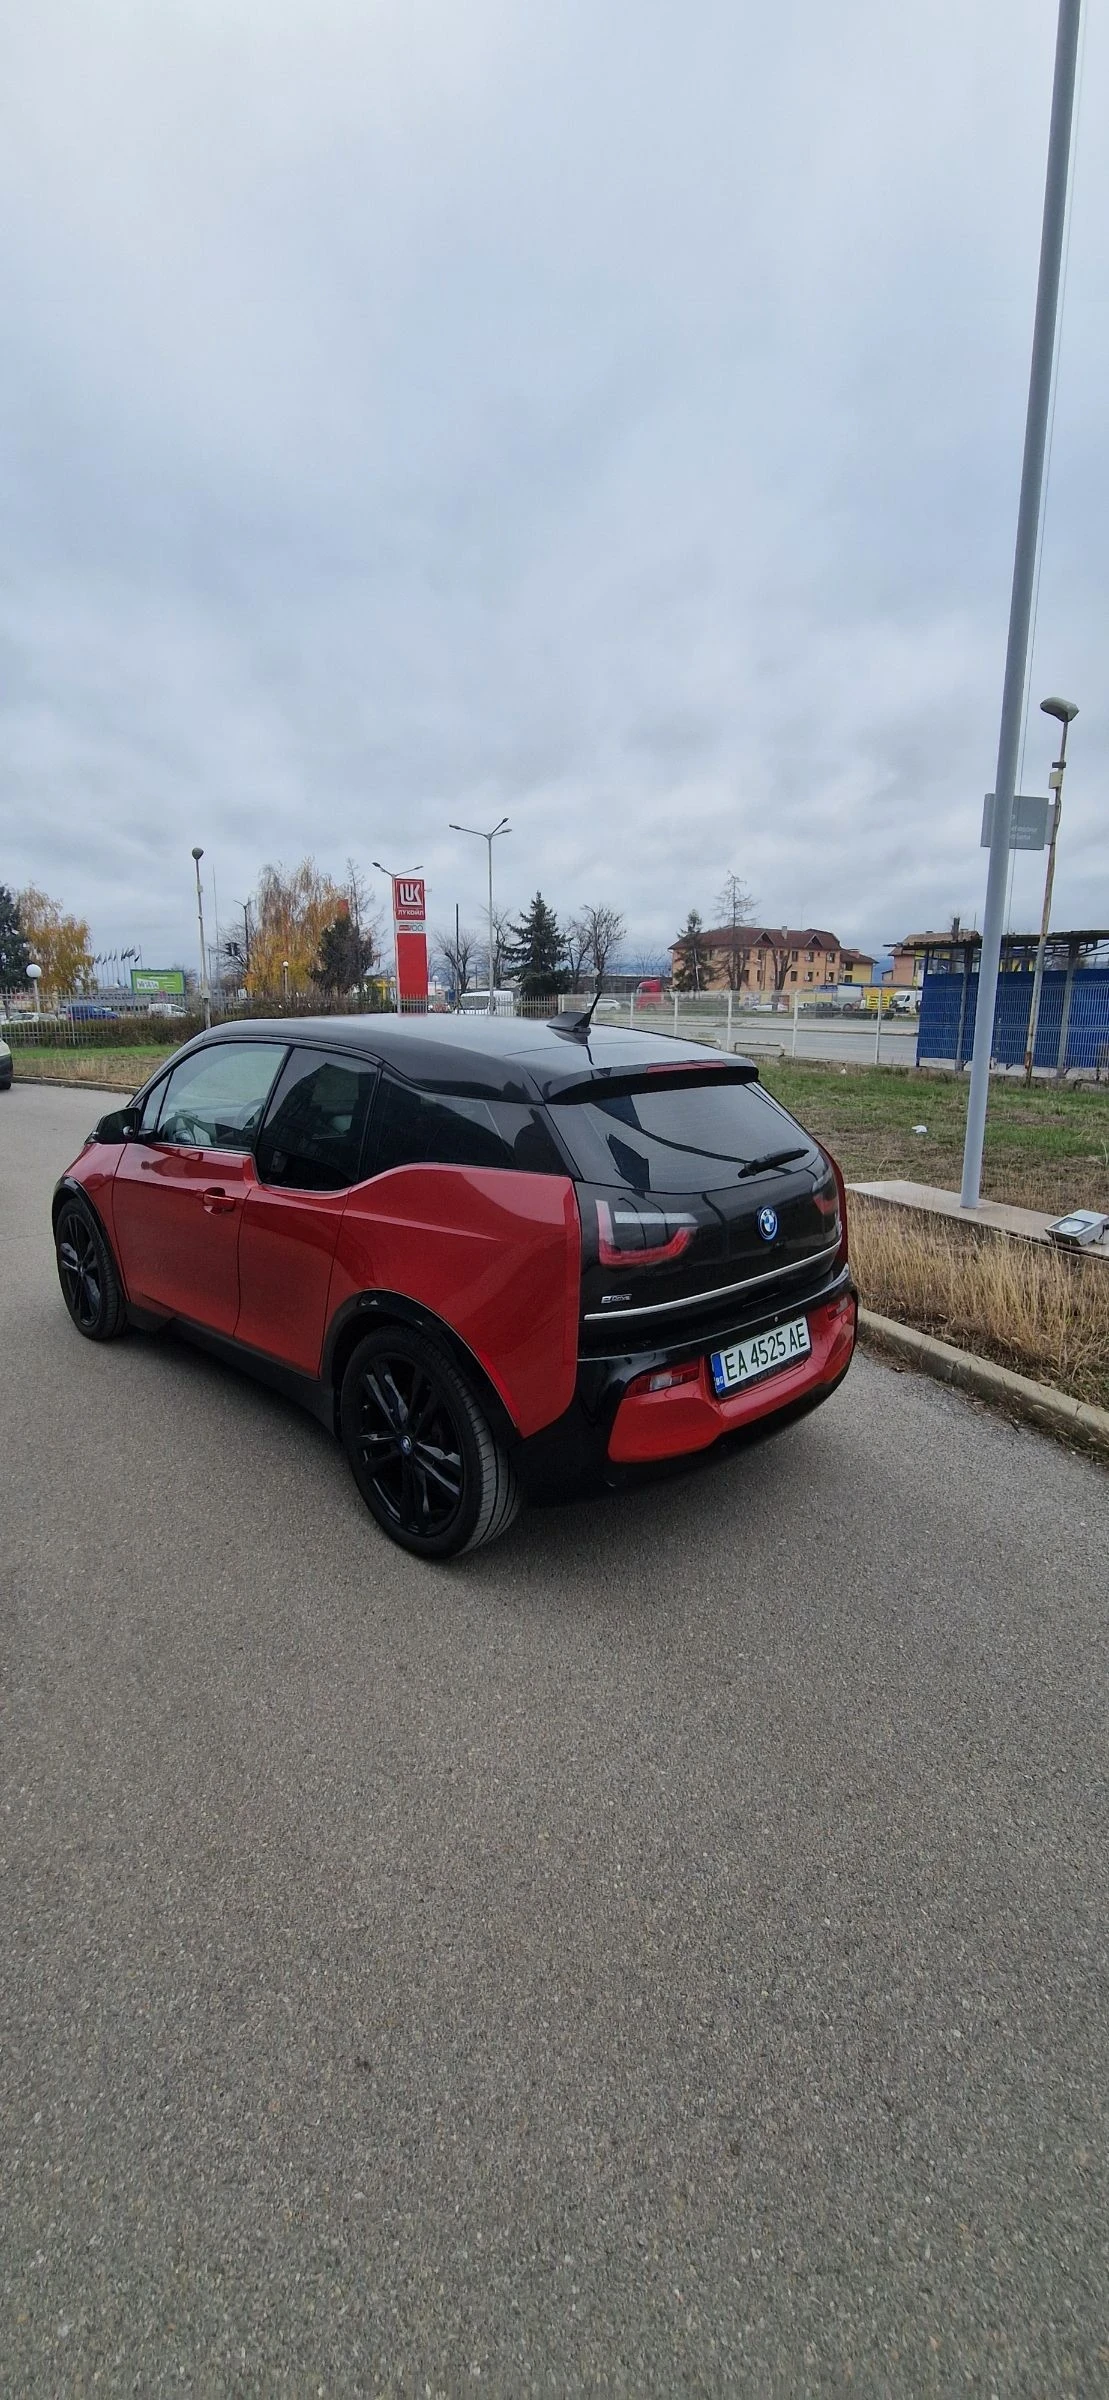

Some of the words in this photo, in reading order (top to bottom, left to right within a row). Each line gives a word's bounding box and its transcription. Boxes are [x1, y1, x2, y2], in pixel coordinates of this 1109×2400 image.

[398, 908, 424, 916] ЛУКОЙЛ
[724, 1349, 748, 1381] EA
[750, 1331, 786, 1368] 4525
[789, 1322, 808, 1353] AE
